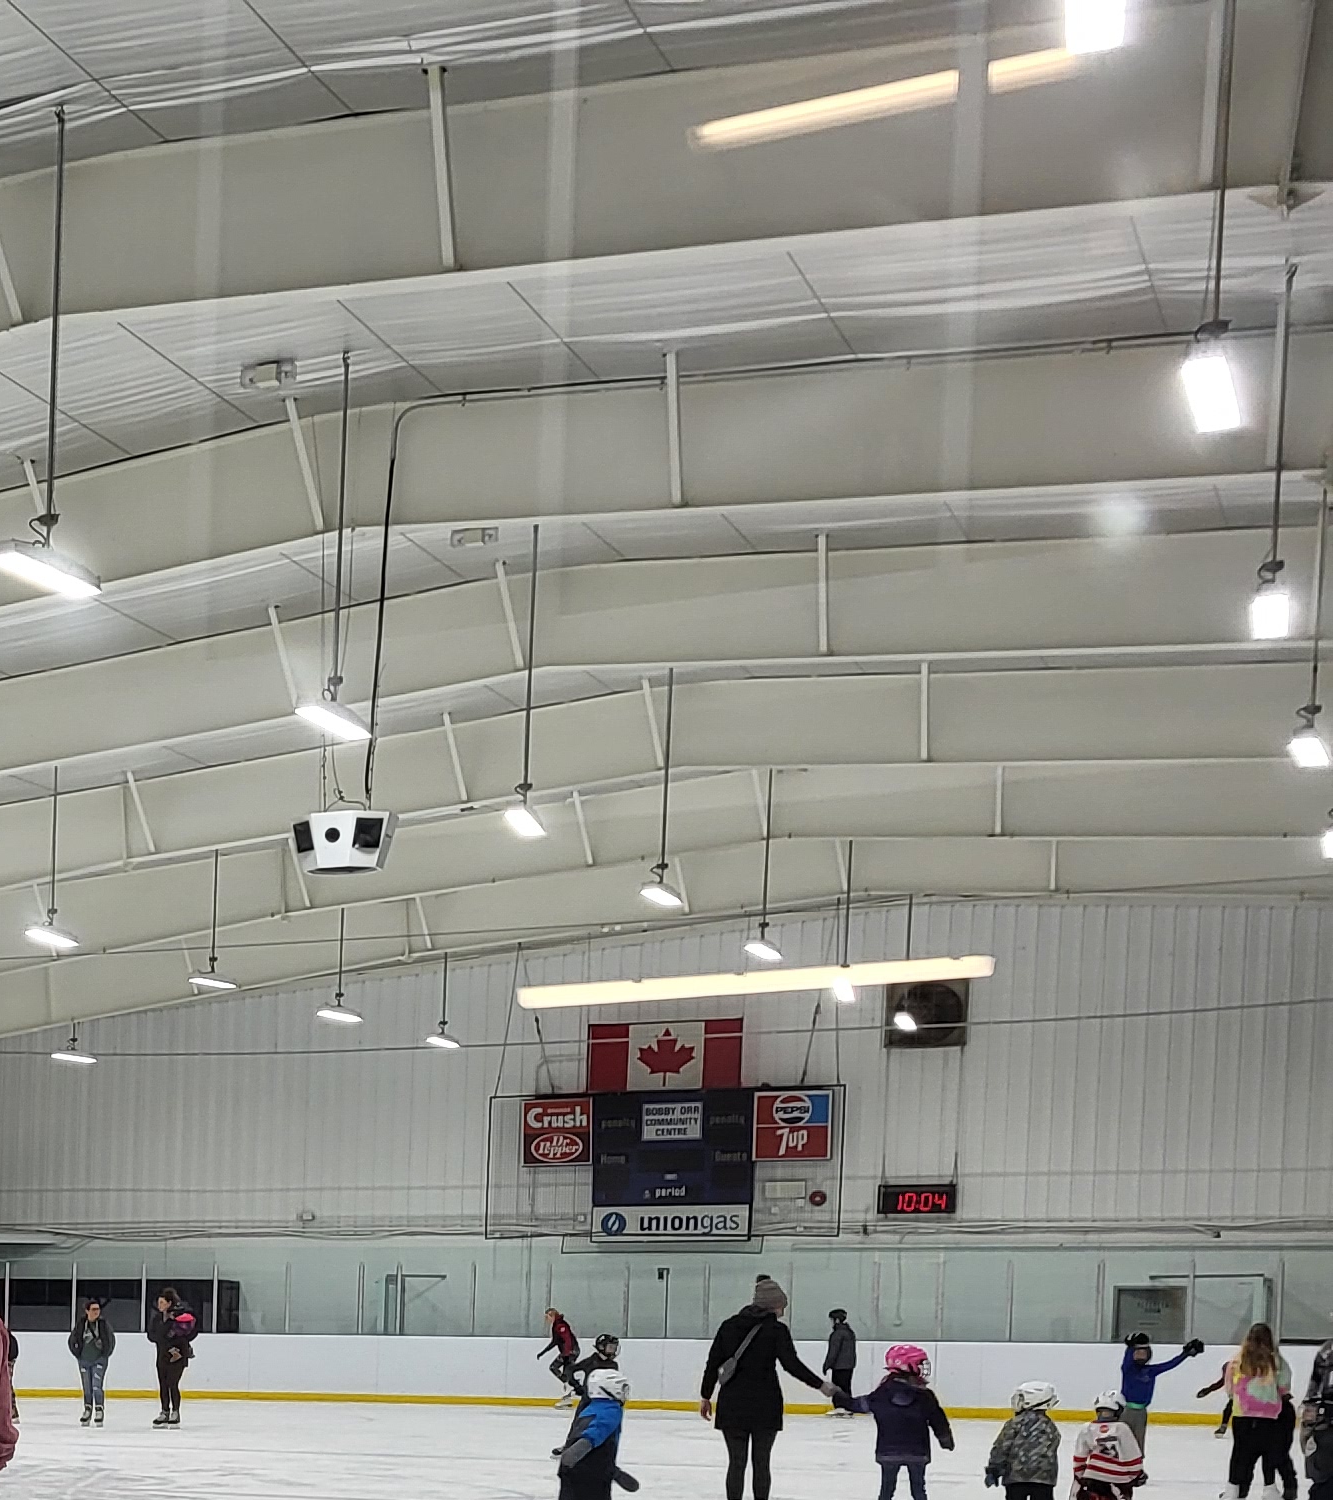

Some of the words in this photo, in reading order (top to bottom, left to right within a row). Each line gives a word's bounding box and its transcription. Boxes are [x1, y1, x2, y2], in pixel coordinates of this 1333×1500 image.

[646, 1106, 676, 1116] BOBBY
[680, 1106, 699, 1115] ORR
[776, 1106, 809, 1115] PEPSI
[527, 1107, 587, 1128] Crush
[646, 1118, 698, 1126] COMMUNITY
[656, 1128, 687, 1136] CENTRE
[551, 1136, 568, 1145] Dr
[776, 1128, 807, 1155] 7up
[656, 1186, 685, 1198] period
[897, 1193, 946, 1212] 10:04
